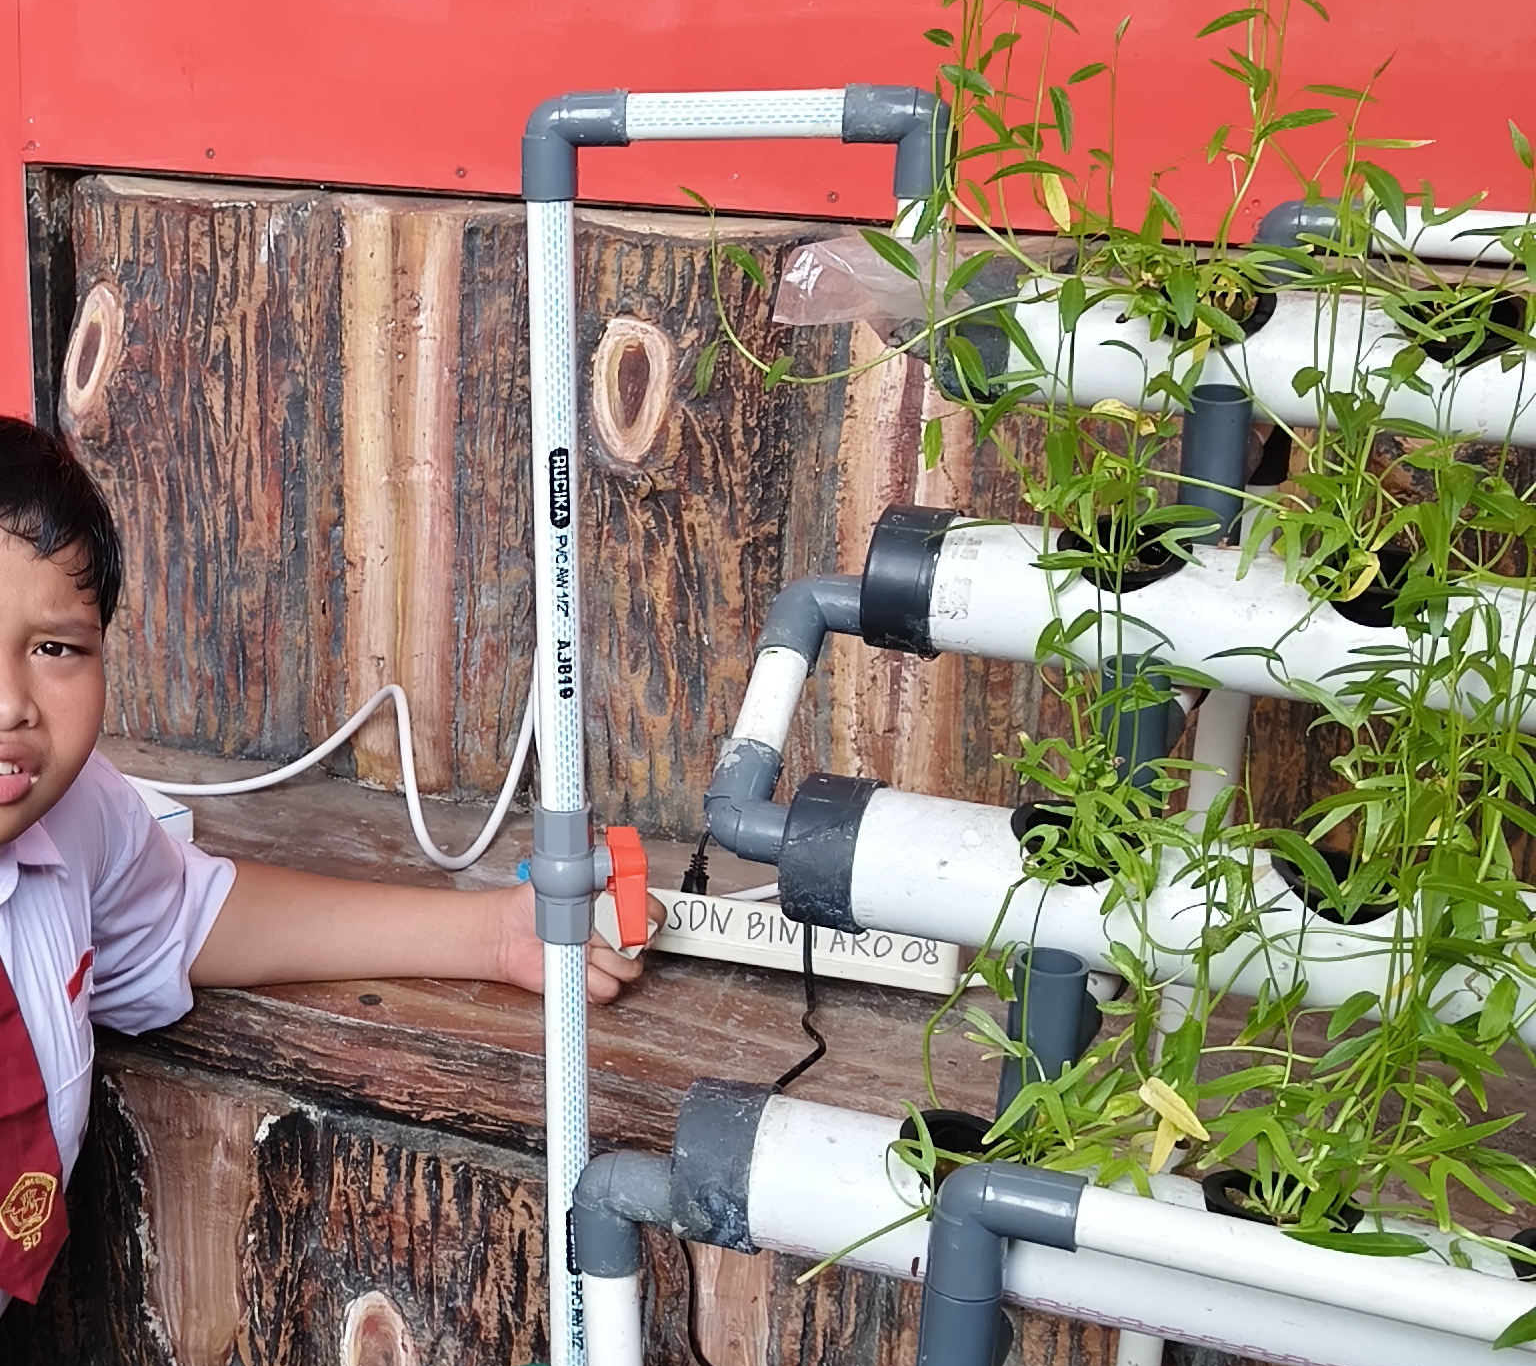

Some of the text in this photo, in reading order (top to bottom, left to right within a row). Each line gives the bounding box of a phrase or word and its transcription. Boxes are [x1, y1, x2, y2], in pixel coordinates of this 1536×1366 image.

[551, 455, 569, 521] RUCIKA
[555, 534, 569, 564] PVC
[556, 566, 570, 590] AW
[667, 899, 733, 935] SDN
[901, 938, 940, 966] 08
[22, 1230, 42, 1252] SD
